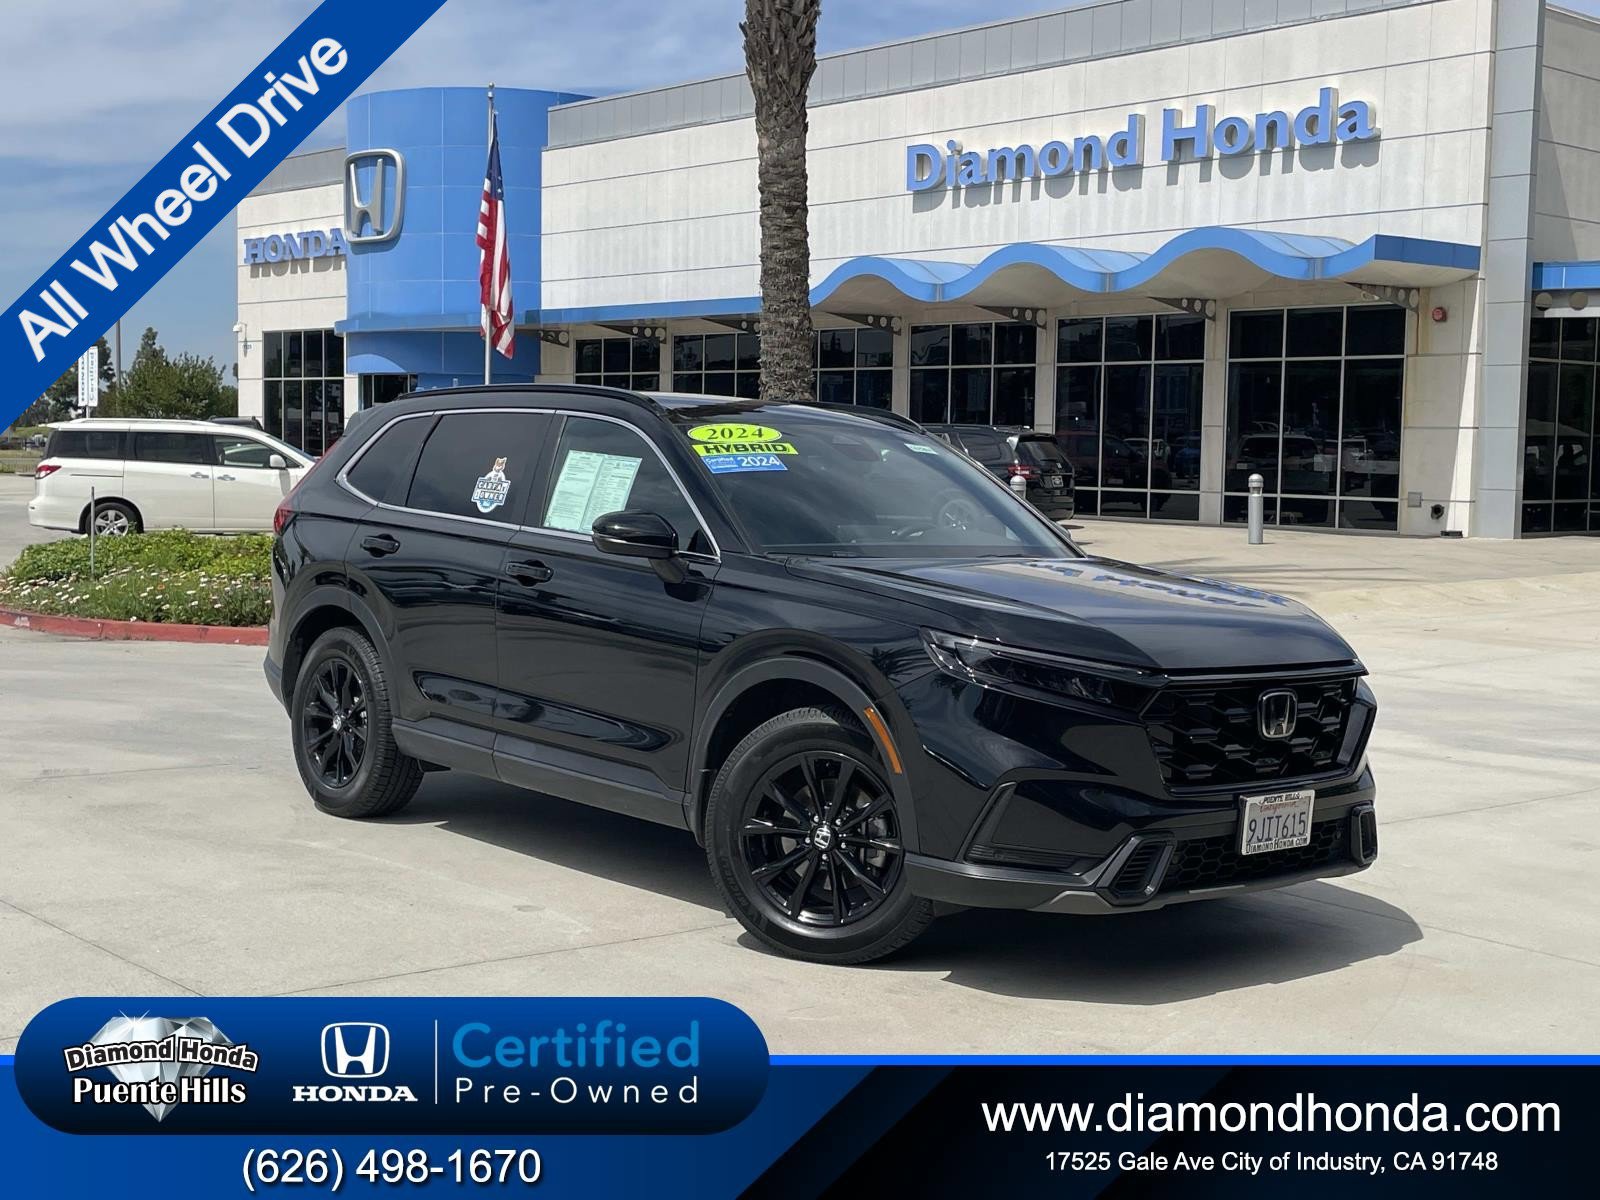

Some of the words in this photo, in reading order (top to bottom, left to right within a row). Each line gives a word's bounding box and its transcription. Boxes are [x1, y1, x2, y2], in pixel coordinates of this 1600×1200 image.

[906, 113, 1144, 192] Diamond
[1162, 86, 1378, 162] Honda
[243, 228, 347, 265] HONDA
[706, 427, 765, 440] 2024
[704, 443, 788, 454] HYBRID
[737, 456, 780, 467] 2024
